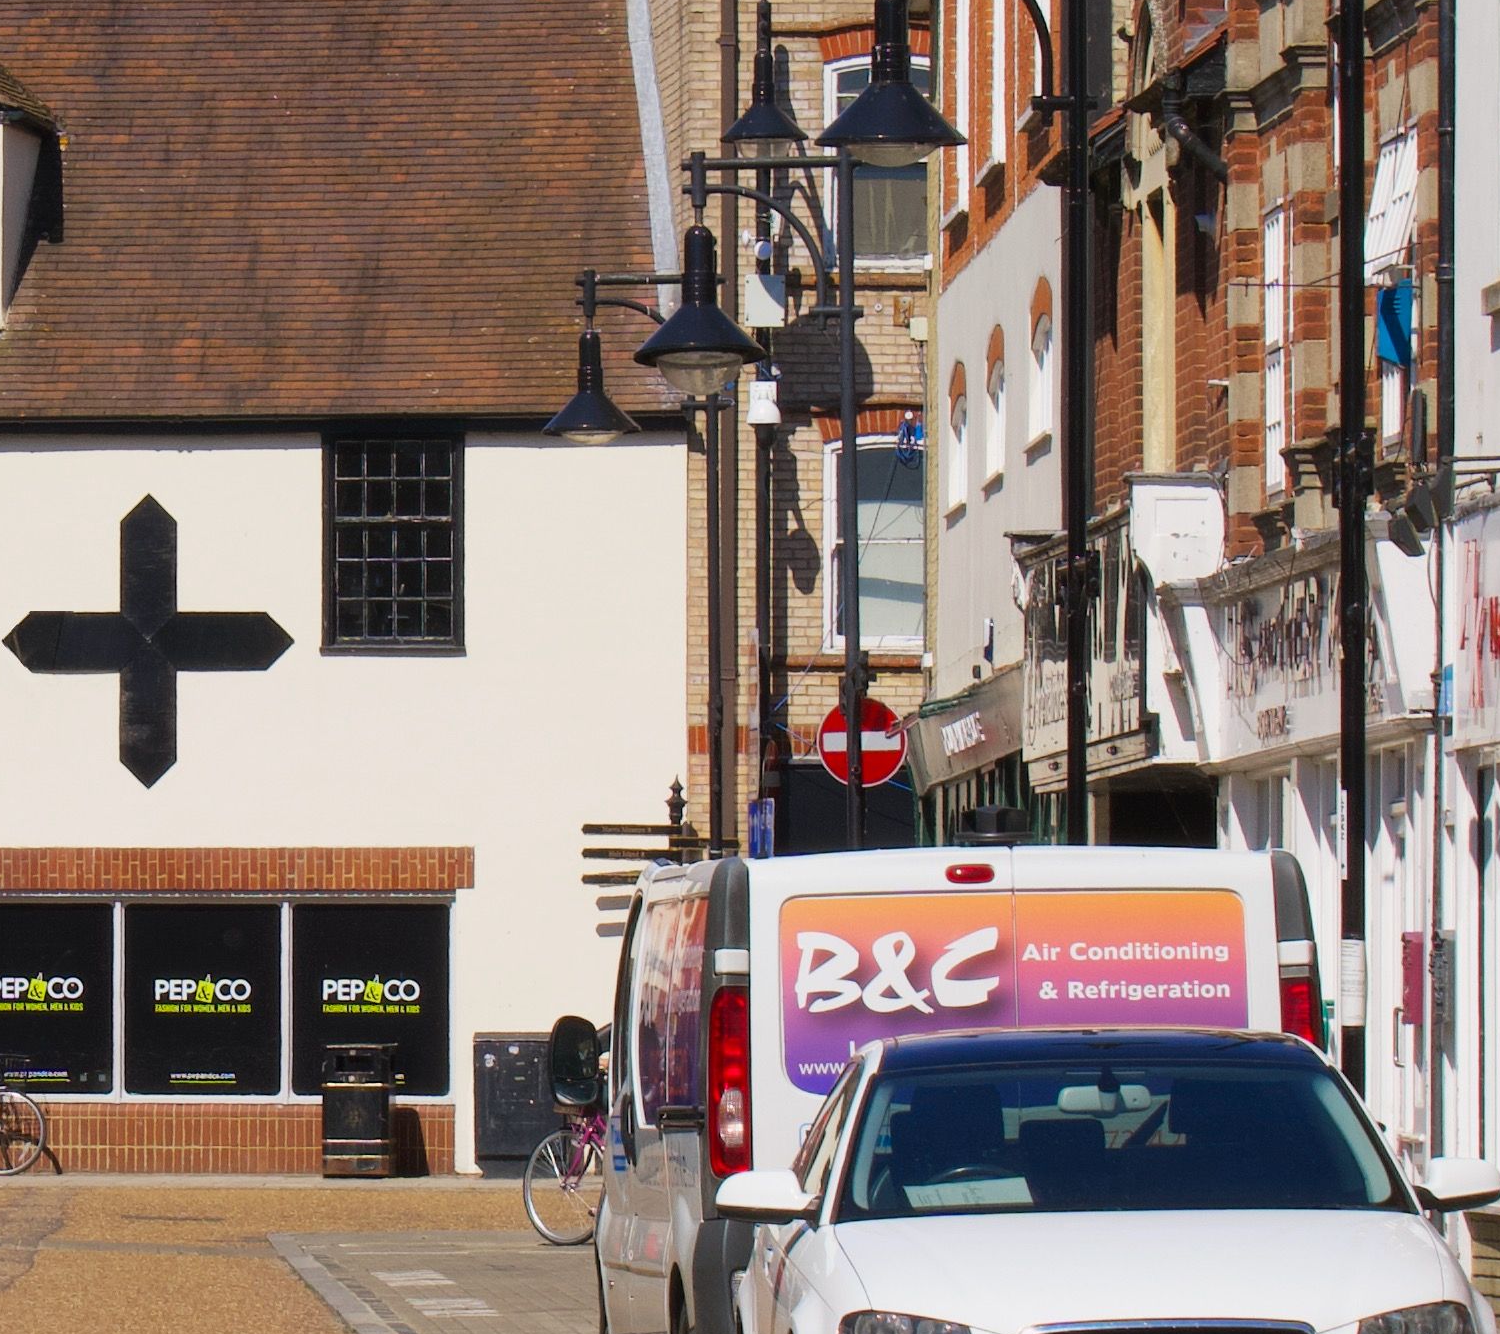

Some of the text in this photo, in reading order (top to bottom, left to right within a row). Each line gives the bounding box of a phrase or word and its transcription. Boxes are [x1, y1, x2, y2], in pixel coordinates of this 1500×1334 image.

[1021, 942, 1229, 966] Air Conditioning
[794, 927, 1000, 1014] B&C
[154, 976, 252, 1003] PEP&CO
[322, 977, 420, 1004] PEP&CO
[1039, 981, 1230, 1004] & Refrigeration
[798, 1061, 846, 1075] www
